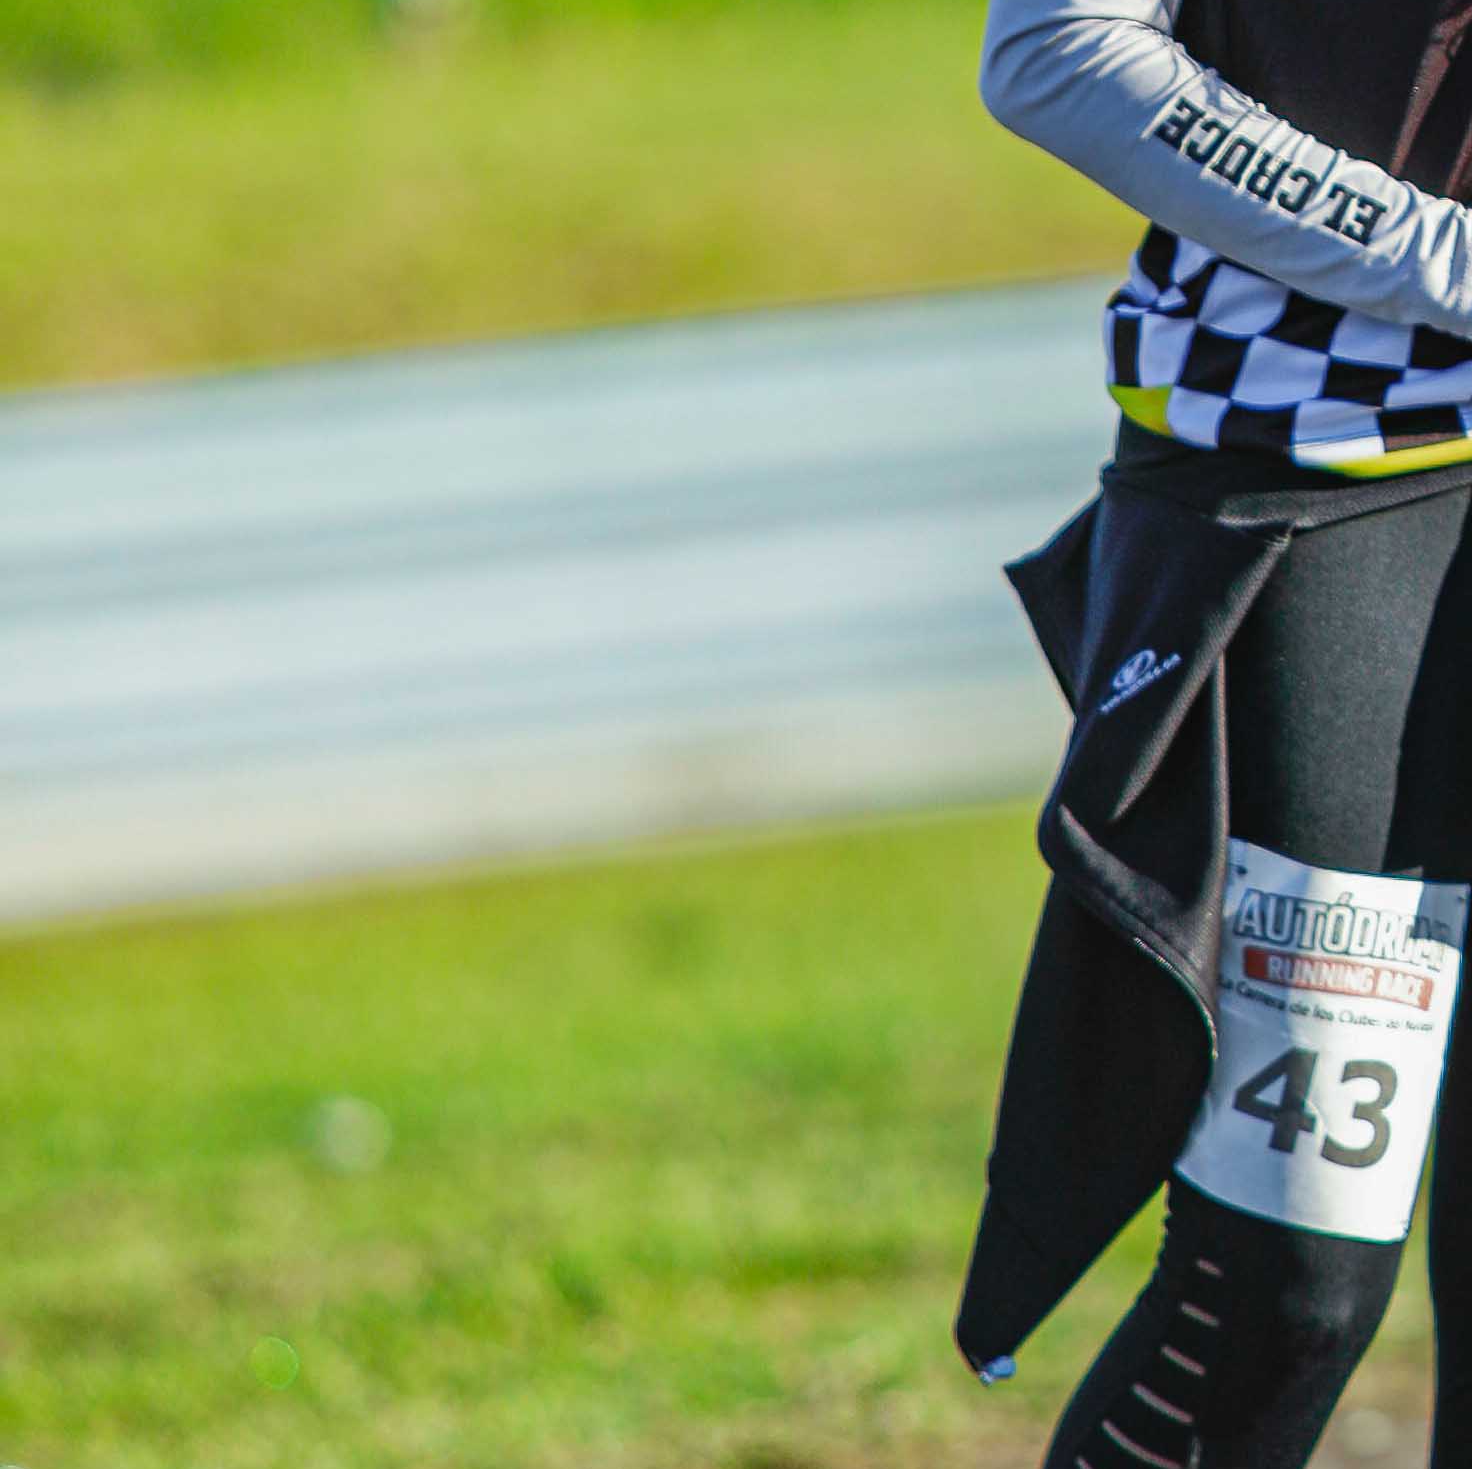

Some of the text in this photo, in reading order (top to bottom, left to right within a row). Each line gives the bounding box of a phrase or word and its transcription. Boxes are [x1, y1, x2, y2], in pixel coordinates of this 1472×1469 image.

[1153, 95, 1388, 247] EL CRUCE
[1267, 954, 1376, 997] RUNNING
[1233, 1046, 1399, 1170] 43
